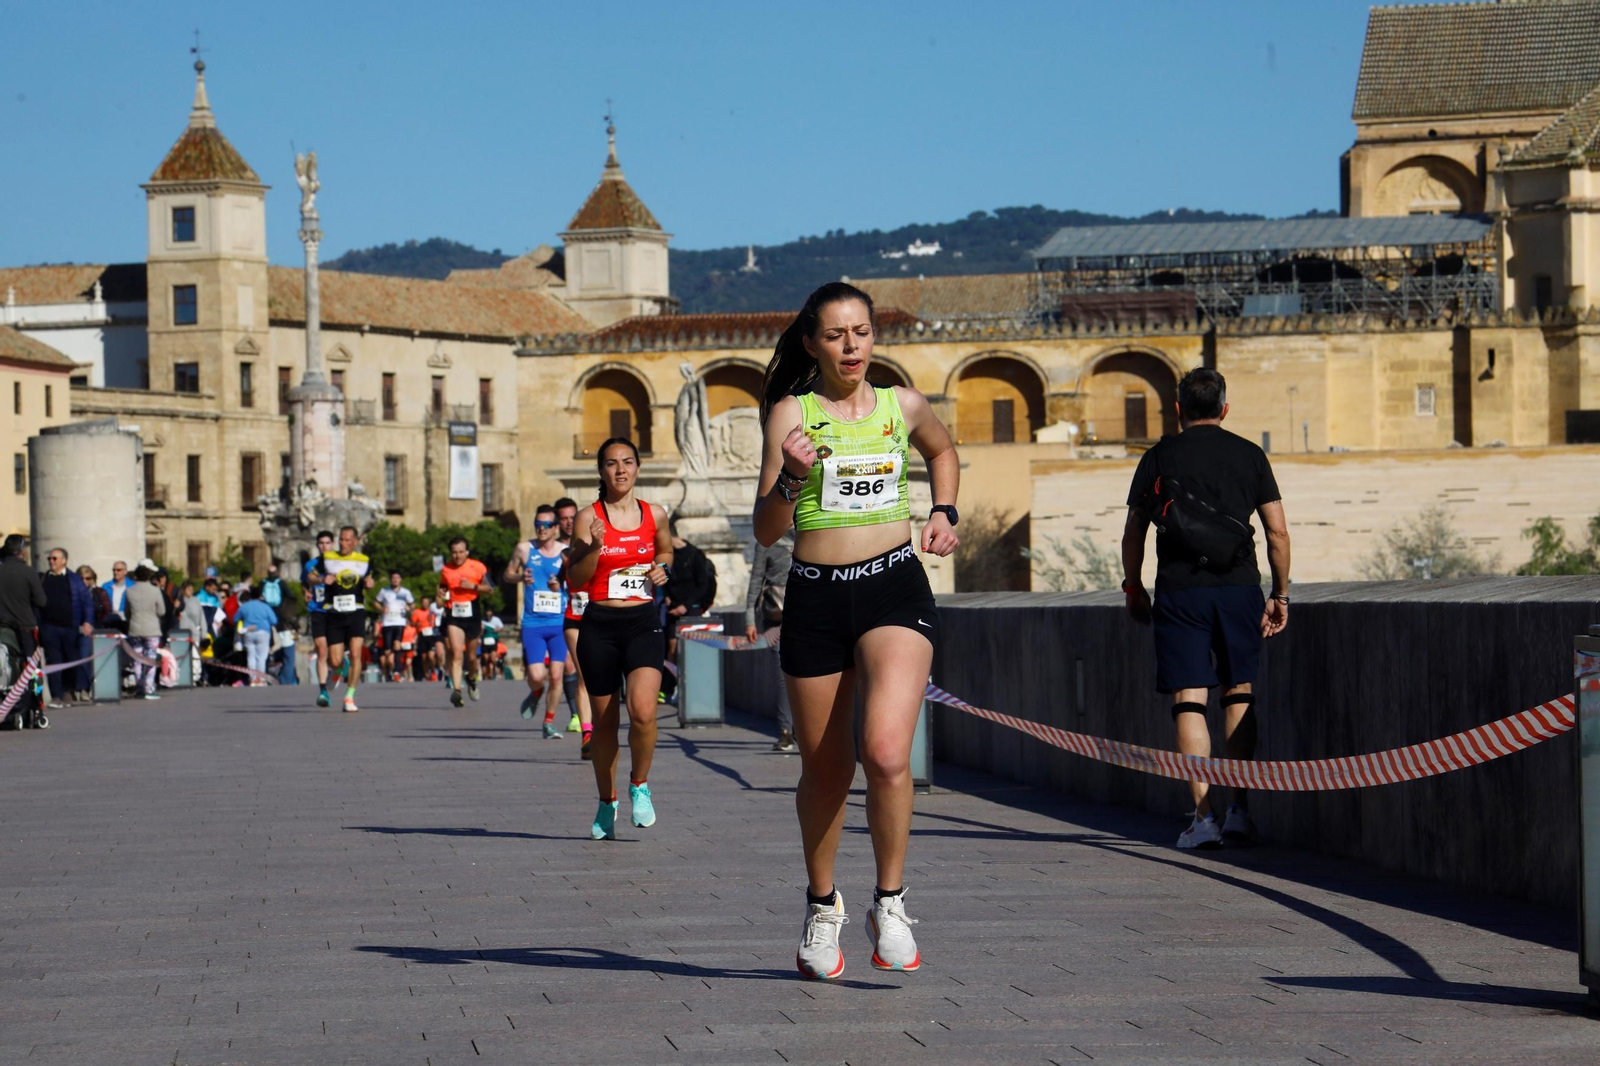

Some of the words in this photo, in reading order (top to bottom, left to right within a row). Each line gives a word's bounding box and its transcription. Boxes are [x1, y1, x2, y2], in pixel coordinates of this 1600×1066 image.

[839, 479, 884, 496] 386
[831, 557, 885, 581] NIKE
[620, 578, 646, 590] 417
